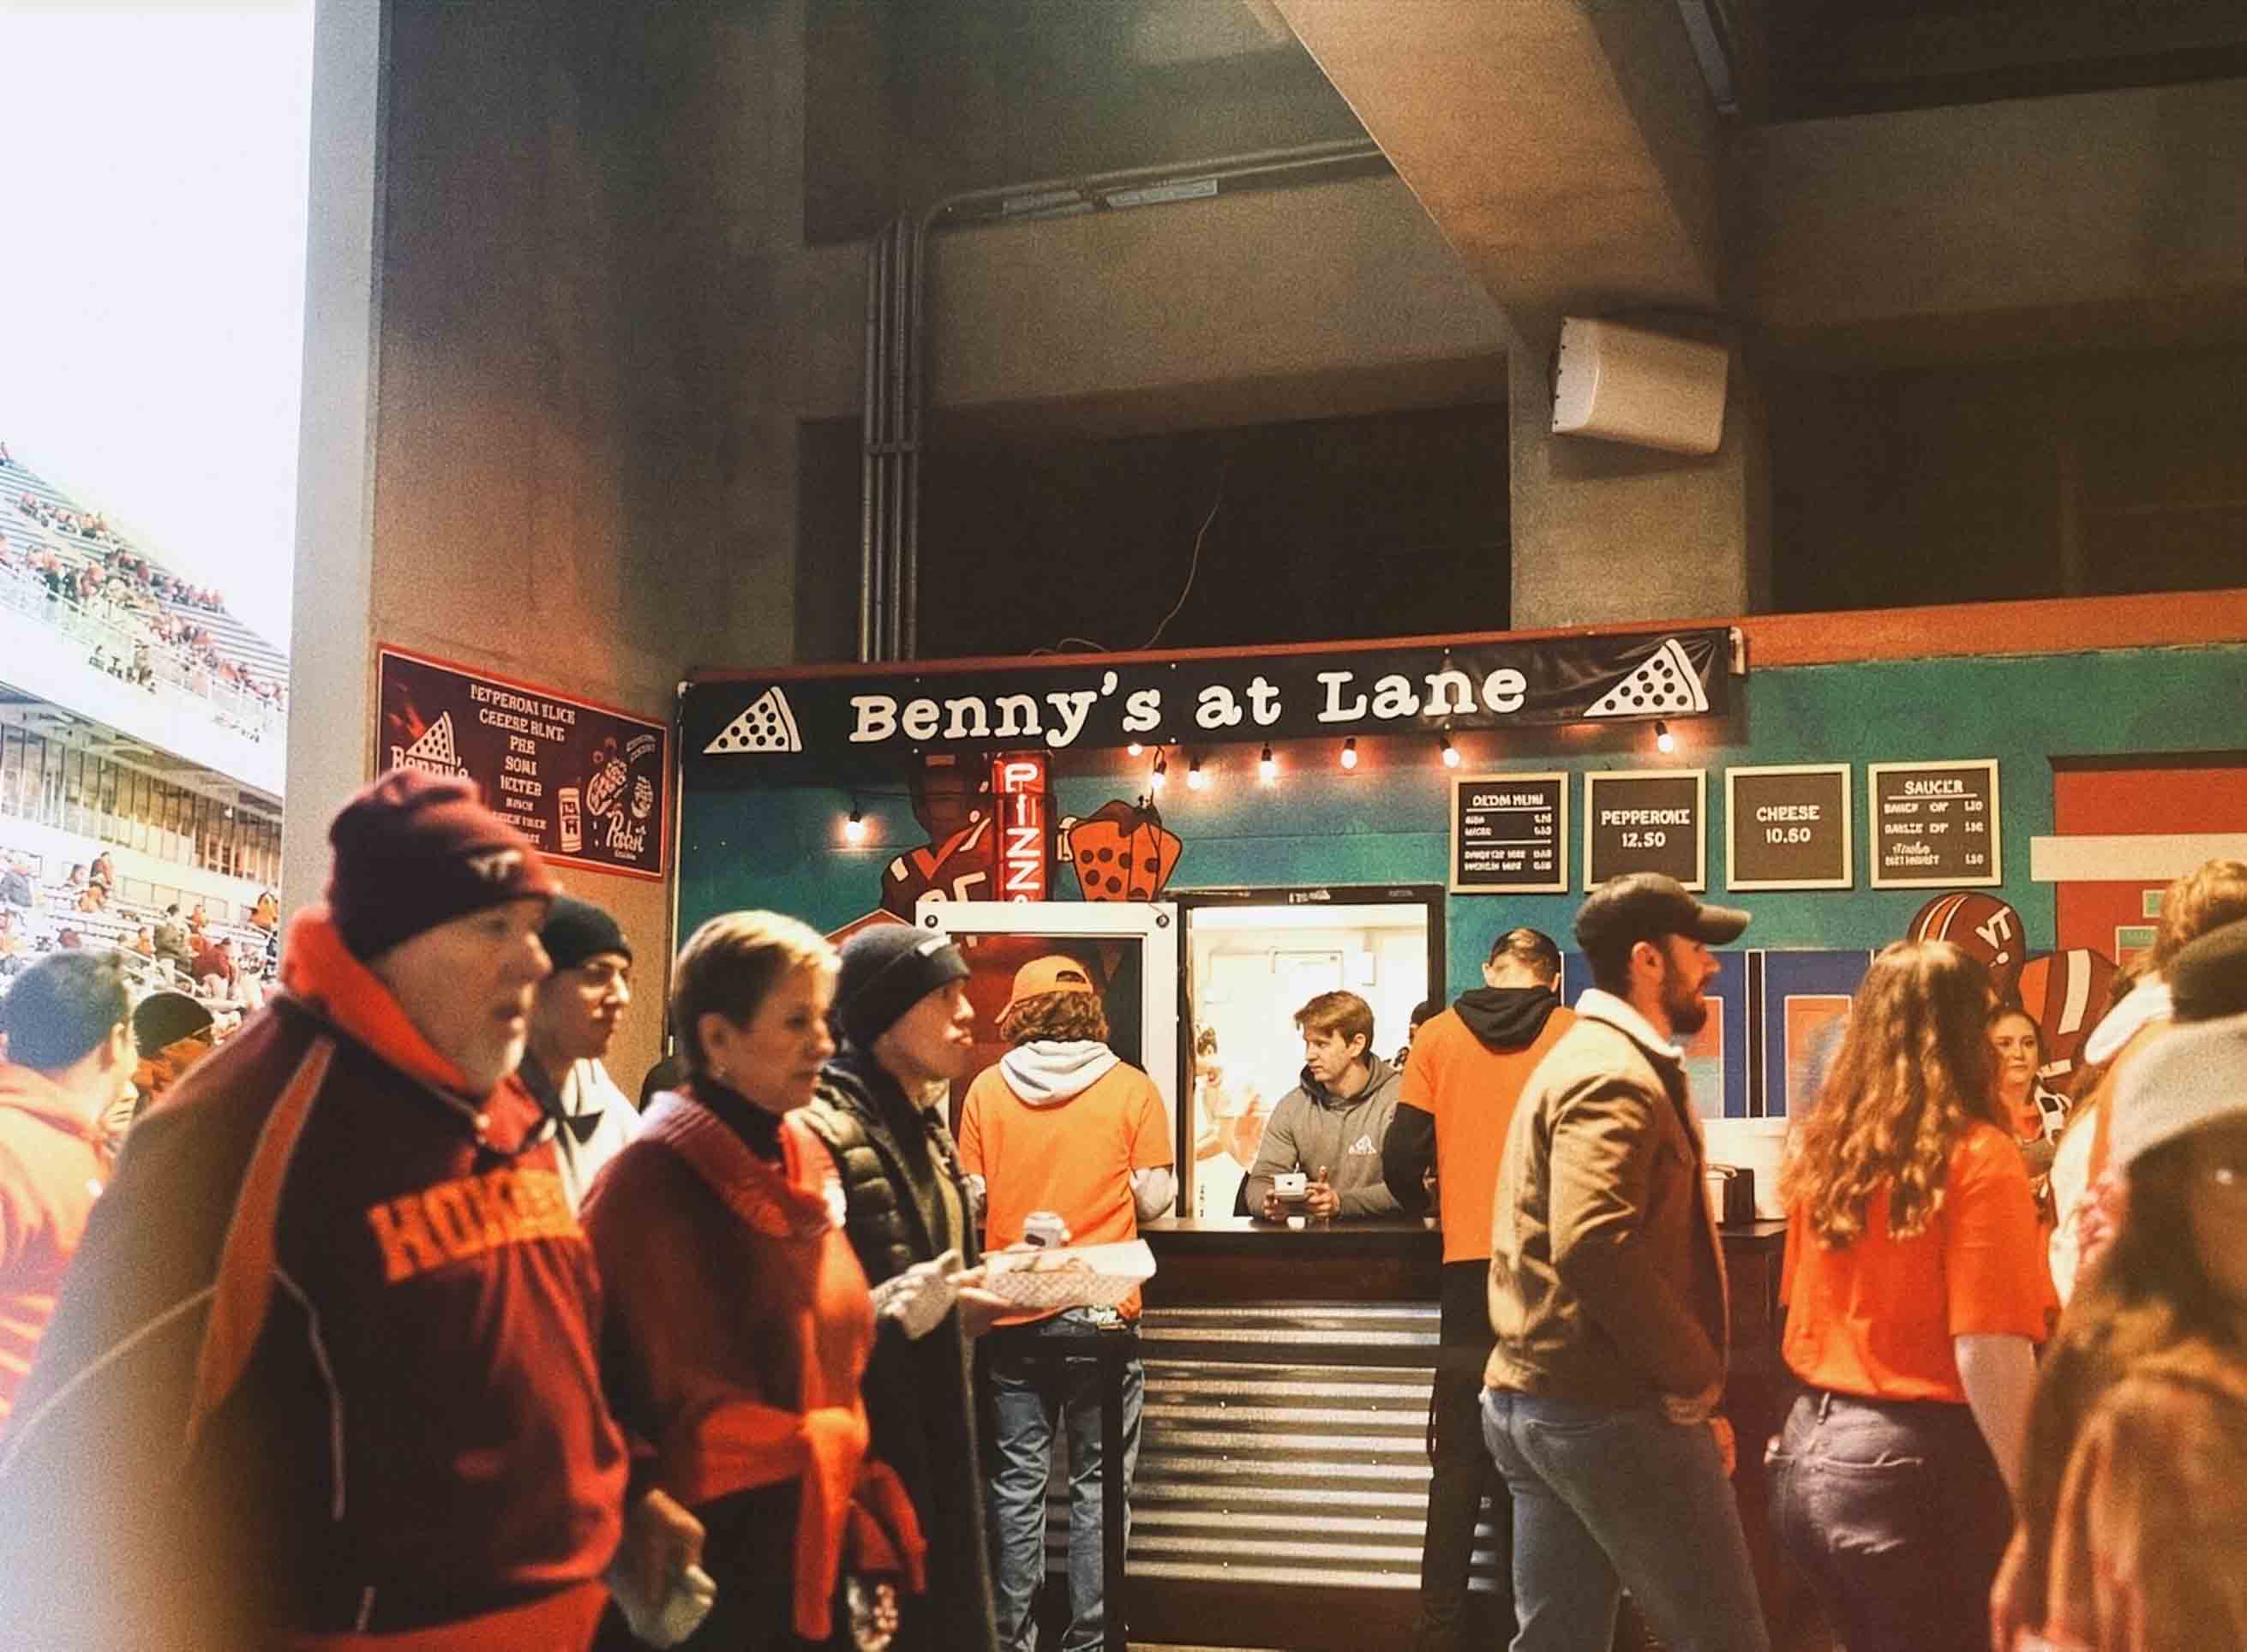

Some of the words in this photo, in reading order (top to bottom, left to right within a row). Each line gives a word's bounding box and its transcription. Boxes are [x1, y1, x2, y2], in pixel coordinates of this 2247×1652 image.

[848, 671, 1161, 748] Benny's
[1195, 676, 1282, 729] at
[1317, 668, 1528, 722] Lane
[1601, 809, 1690, 826] PEPPERONI
[1622, 831, 1666, 847] 12.50
